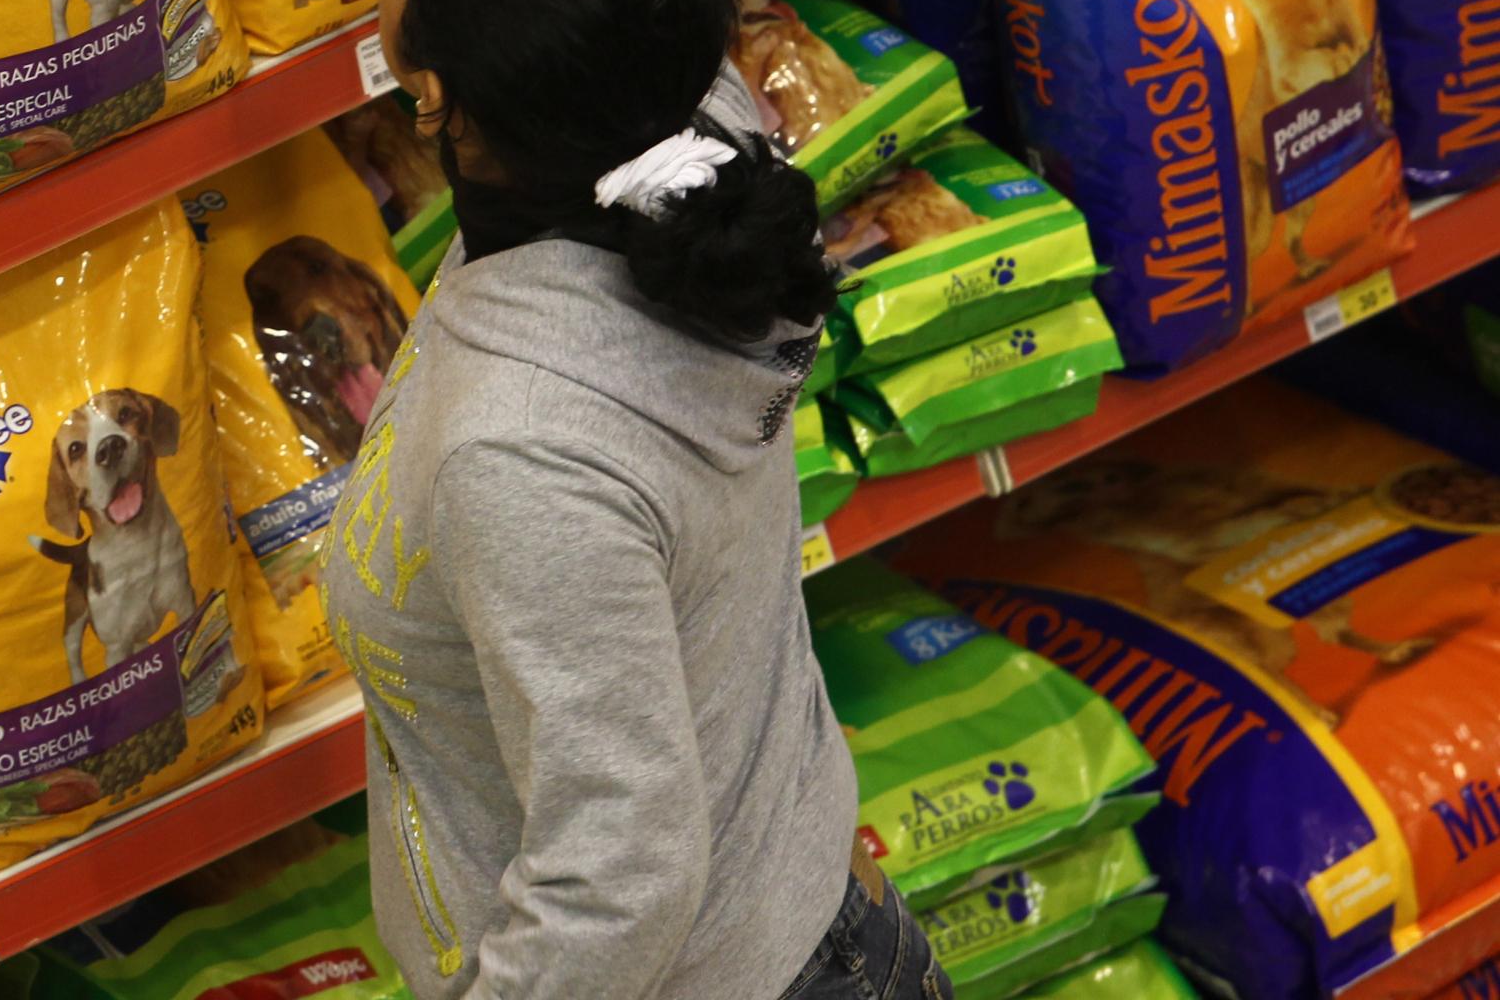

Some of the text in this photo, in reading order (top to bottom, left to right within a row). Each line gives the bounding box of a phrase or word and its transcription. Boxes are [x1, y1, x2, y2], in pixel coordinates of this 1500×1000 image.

[0, 58, 57, 88] RAZAS
[62, 15, 146, 69] PEQUEÑAS
[10, 113, 43, 129] SPECIAL
[45, 104, 67, 118] CARE
[1272, 105, 1321, 150] pollo
[1288, 101, 1365, 159] cereales
[247, 499, 308, 539] adulto
[20, 700, 76, 732] RAZAS
[80, 653, 163, 707] PEQUEÑAS
[18, 724, 94, 768] ESPECIAL
[912, 800, 1005, 851] PERROS
